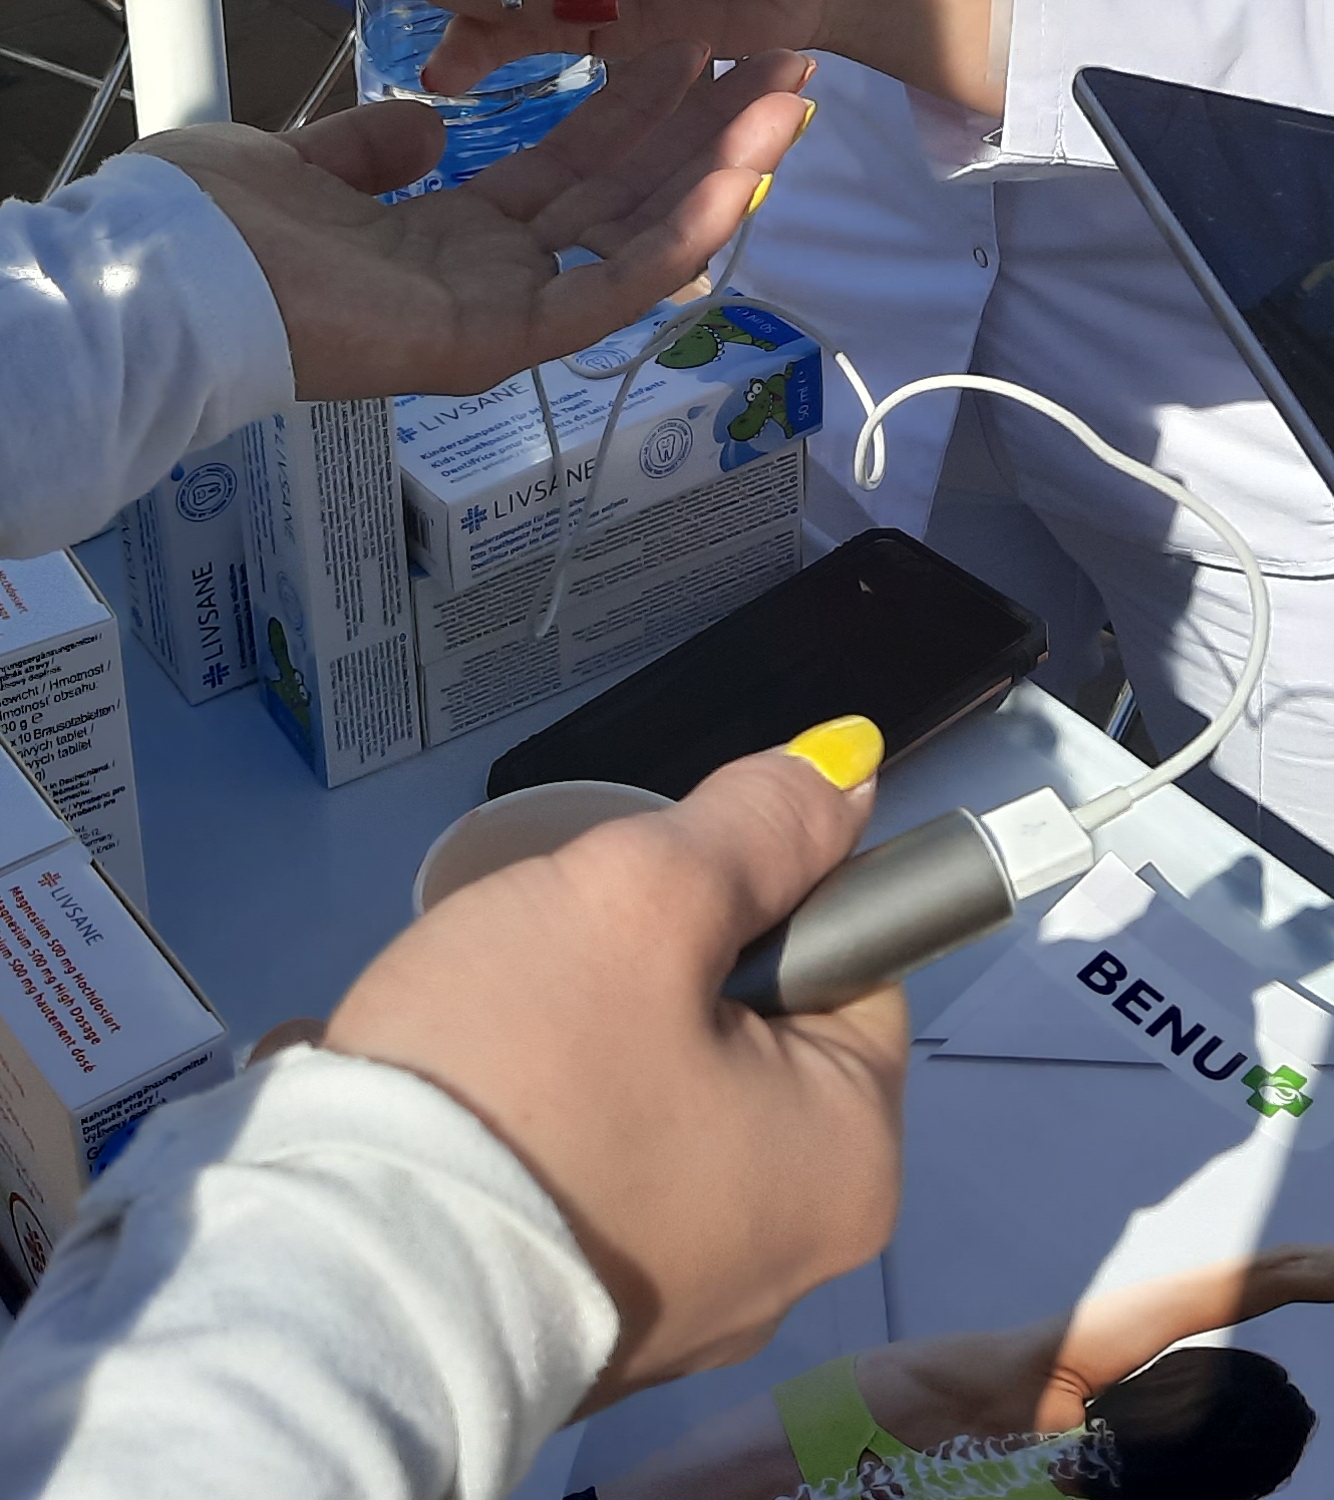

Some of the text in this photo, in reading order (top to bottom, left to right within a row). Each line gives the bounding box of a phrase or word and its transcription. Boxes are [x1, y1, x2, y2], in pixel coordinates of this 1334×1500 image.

[419, 382, 530, 431] LIVSANE
[192, 561, 224, 662] LIVSANE
[49, 663, 105, 691] Hmotnost
[8, 885, 122, 1034] Magnesium 500 mg Hochdosiert
[50, 886, 104, 947] LIVSANE
[8, 958, 28, 979] 500
[21, 977, 38, 996] mg
[32, 992, 76, 1049] hautement
[71, 1047, 97, 1074] dosé
[27, 948, 48, 968] 500
[40, 967, 57, 986] mg
[52, 982, 76, 1008] High
[69, 1006, 101, 1046] Dosage
[1076, 949, 1249, 1082] BENU
